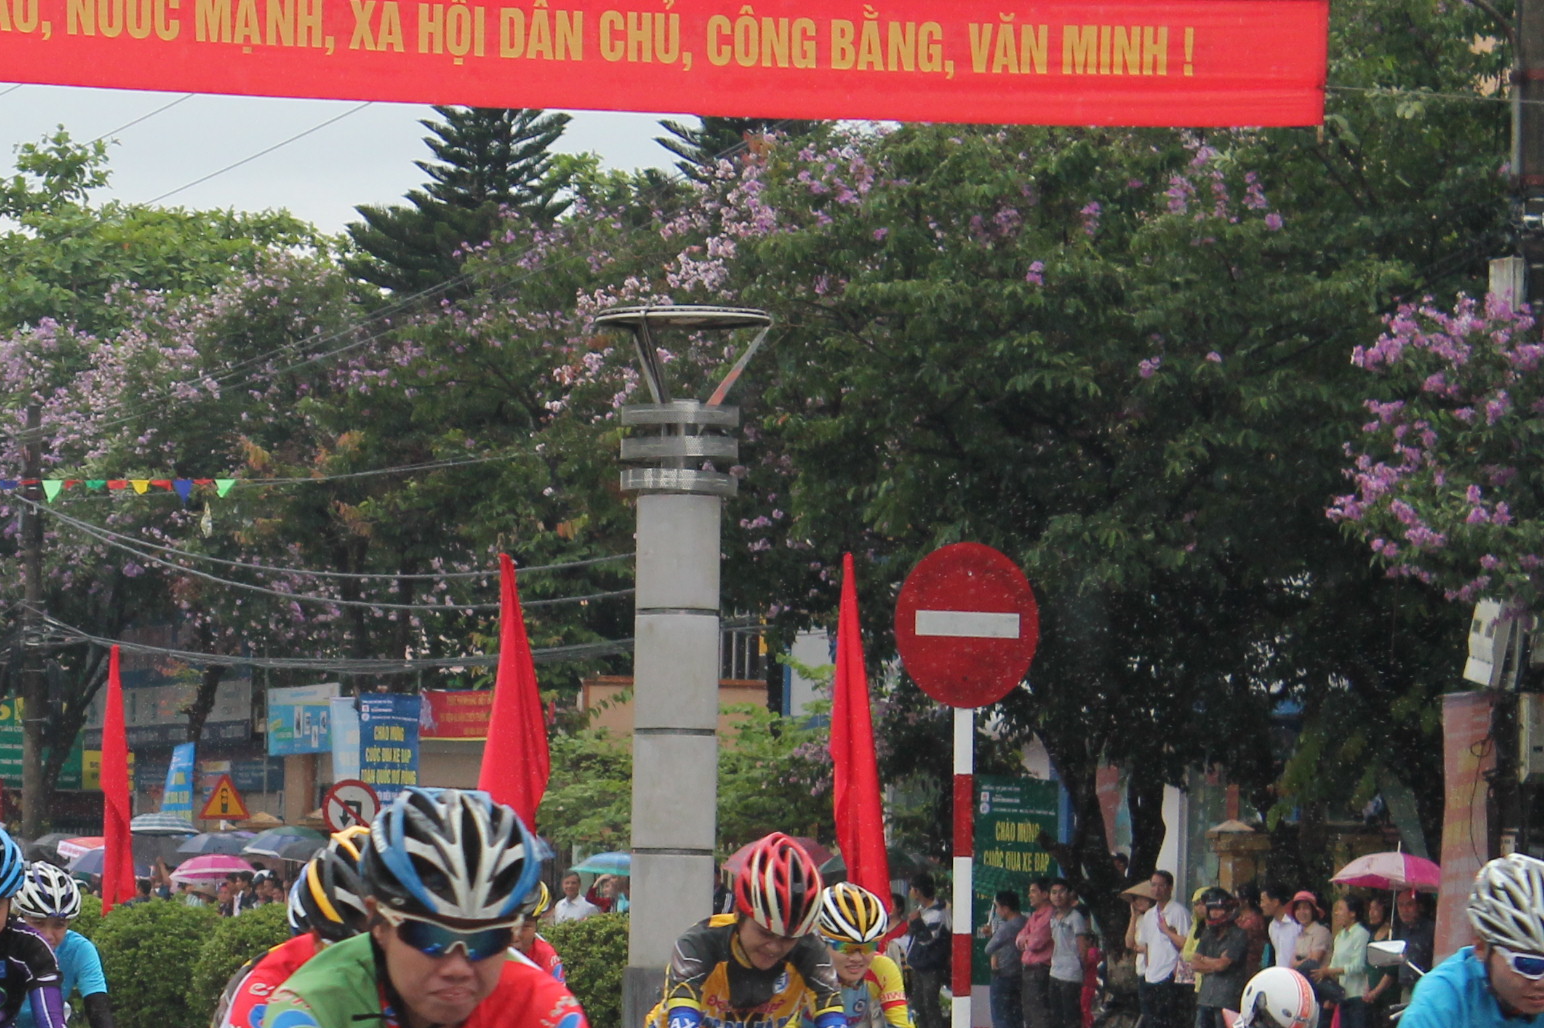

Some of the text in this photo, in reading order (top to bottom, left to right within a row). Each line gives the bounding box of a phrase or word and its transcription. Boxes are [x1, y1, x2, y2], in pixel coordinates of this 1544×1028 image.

[195, 0, 335, 55] MẠNH,
[500, 0, 583, 61] DÂN
[600, 0, 692, 72] CHỦ,
[707, 5, 816, 69] CÔNG
[831, 4, 954, 79] BẰNG,
[968, 12, 1047, 75] VĂN
[1062, 25, 1168, 76] MINH
[995, 818, 1016, 842] CHÀO
[1005, 851, 1022, 872] ĐUA
[1022, 852, 1033, 873] XE
